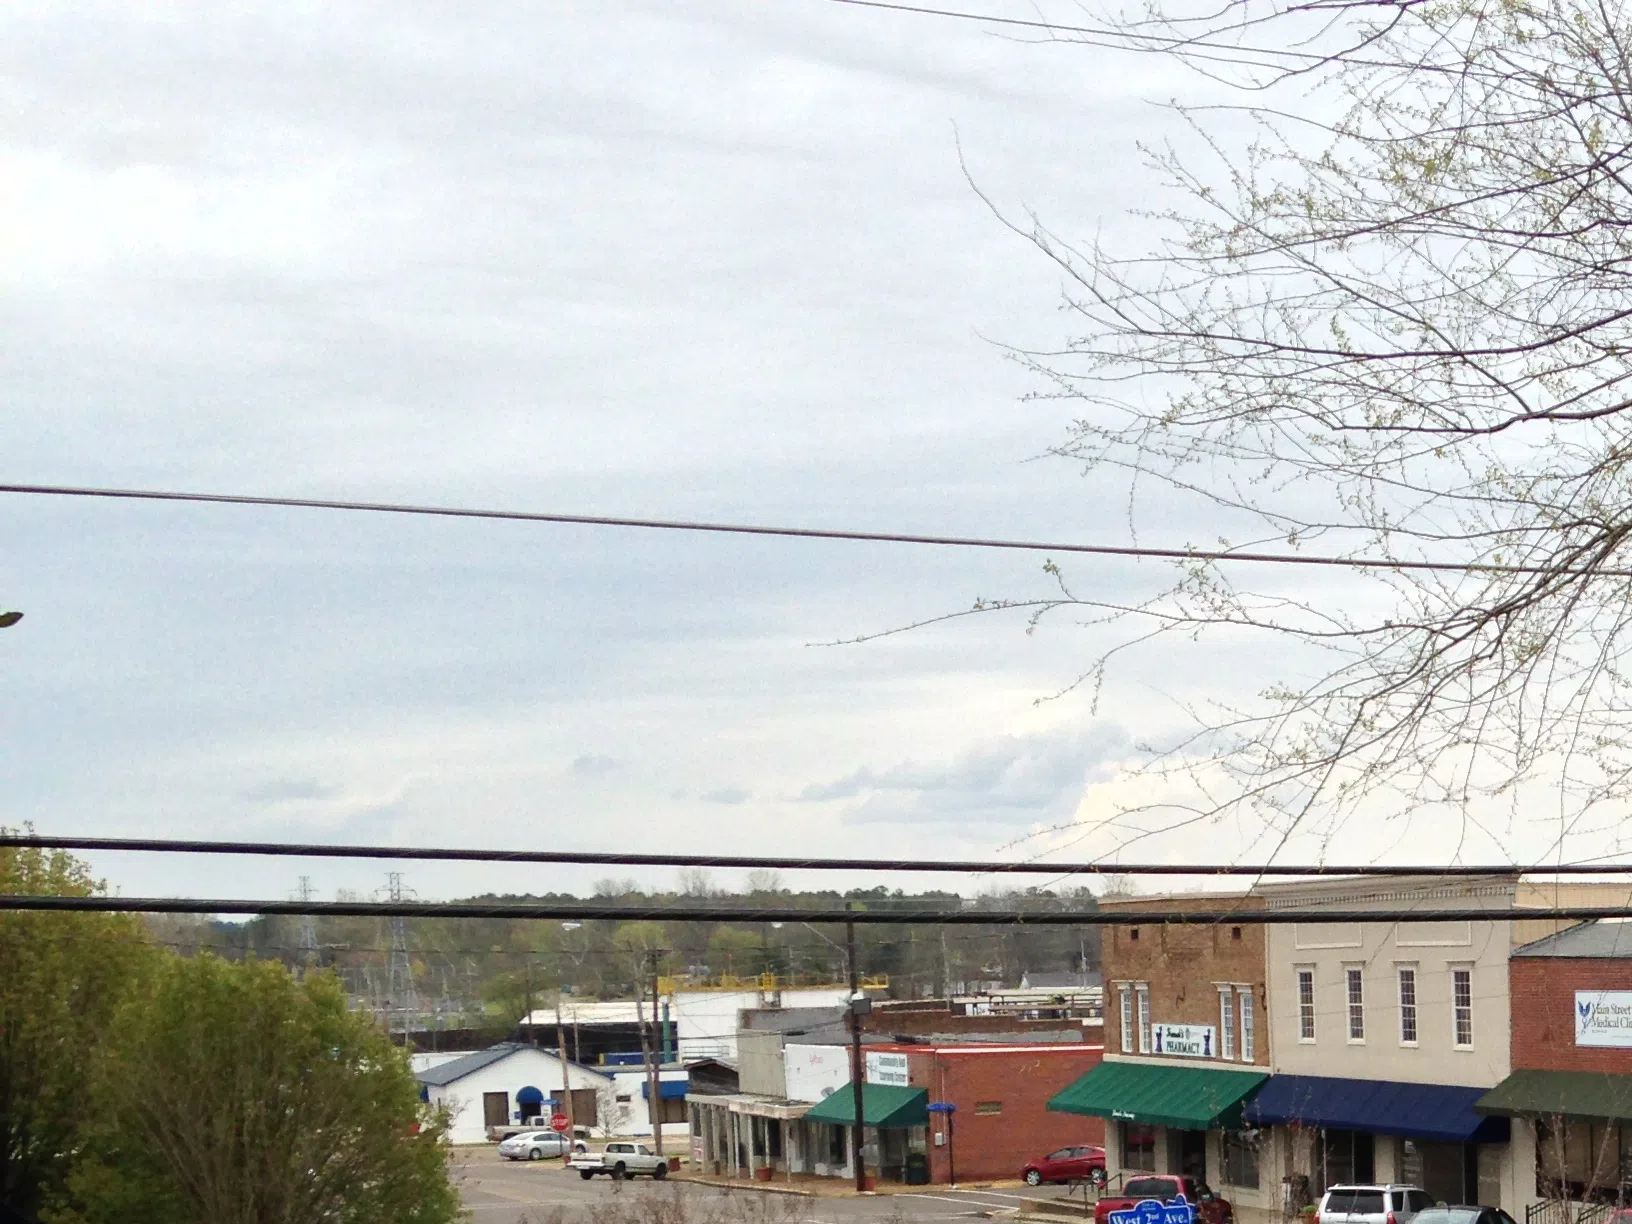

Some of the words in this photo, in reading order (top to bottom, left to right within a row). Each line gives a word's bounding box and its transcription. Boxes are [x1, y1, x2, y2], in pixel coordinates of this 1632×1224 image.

[1611, 1003, 1631, 1015] Street
[1166, 1041, 1200, 1054] PHARMACY
[551, 1118, 568, 1127] STOP
[1164, 1213, 1188, 1224] Ave.
